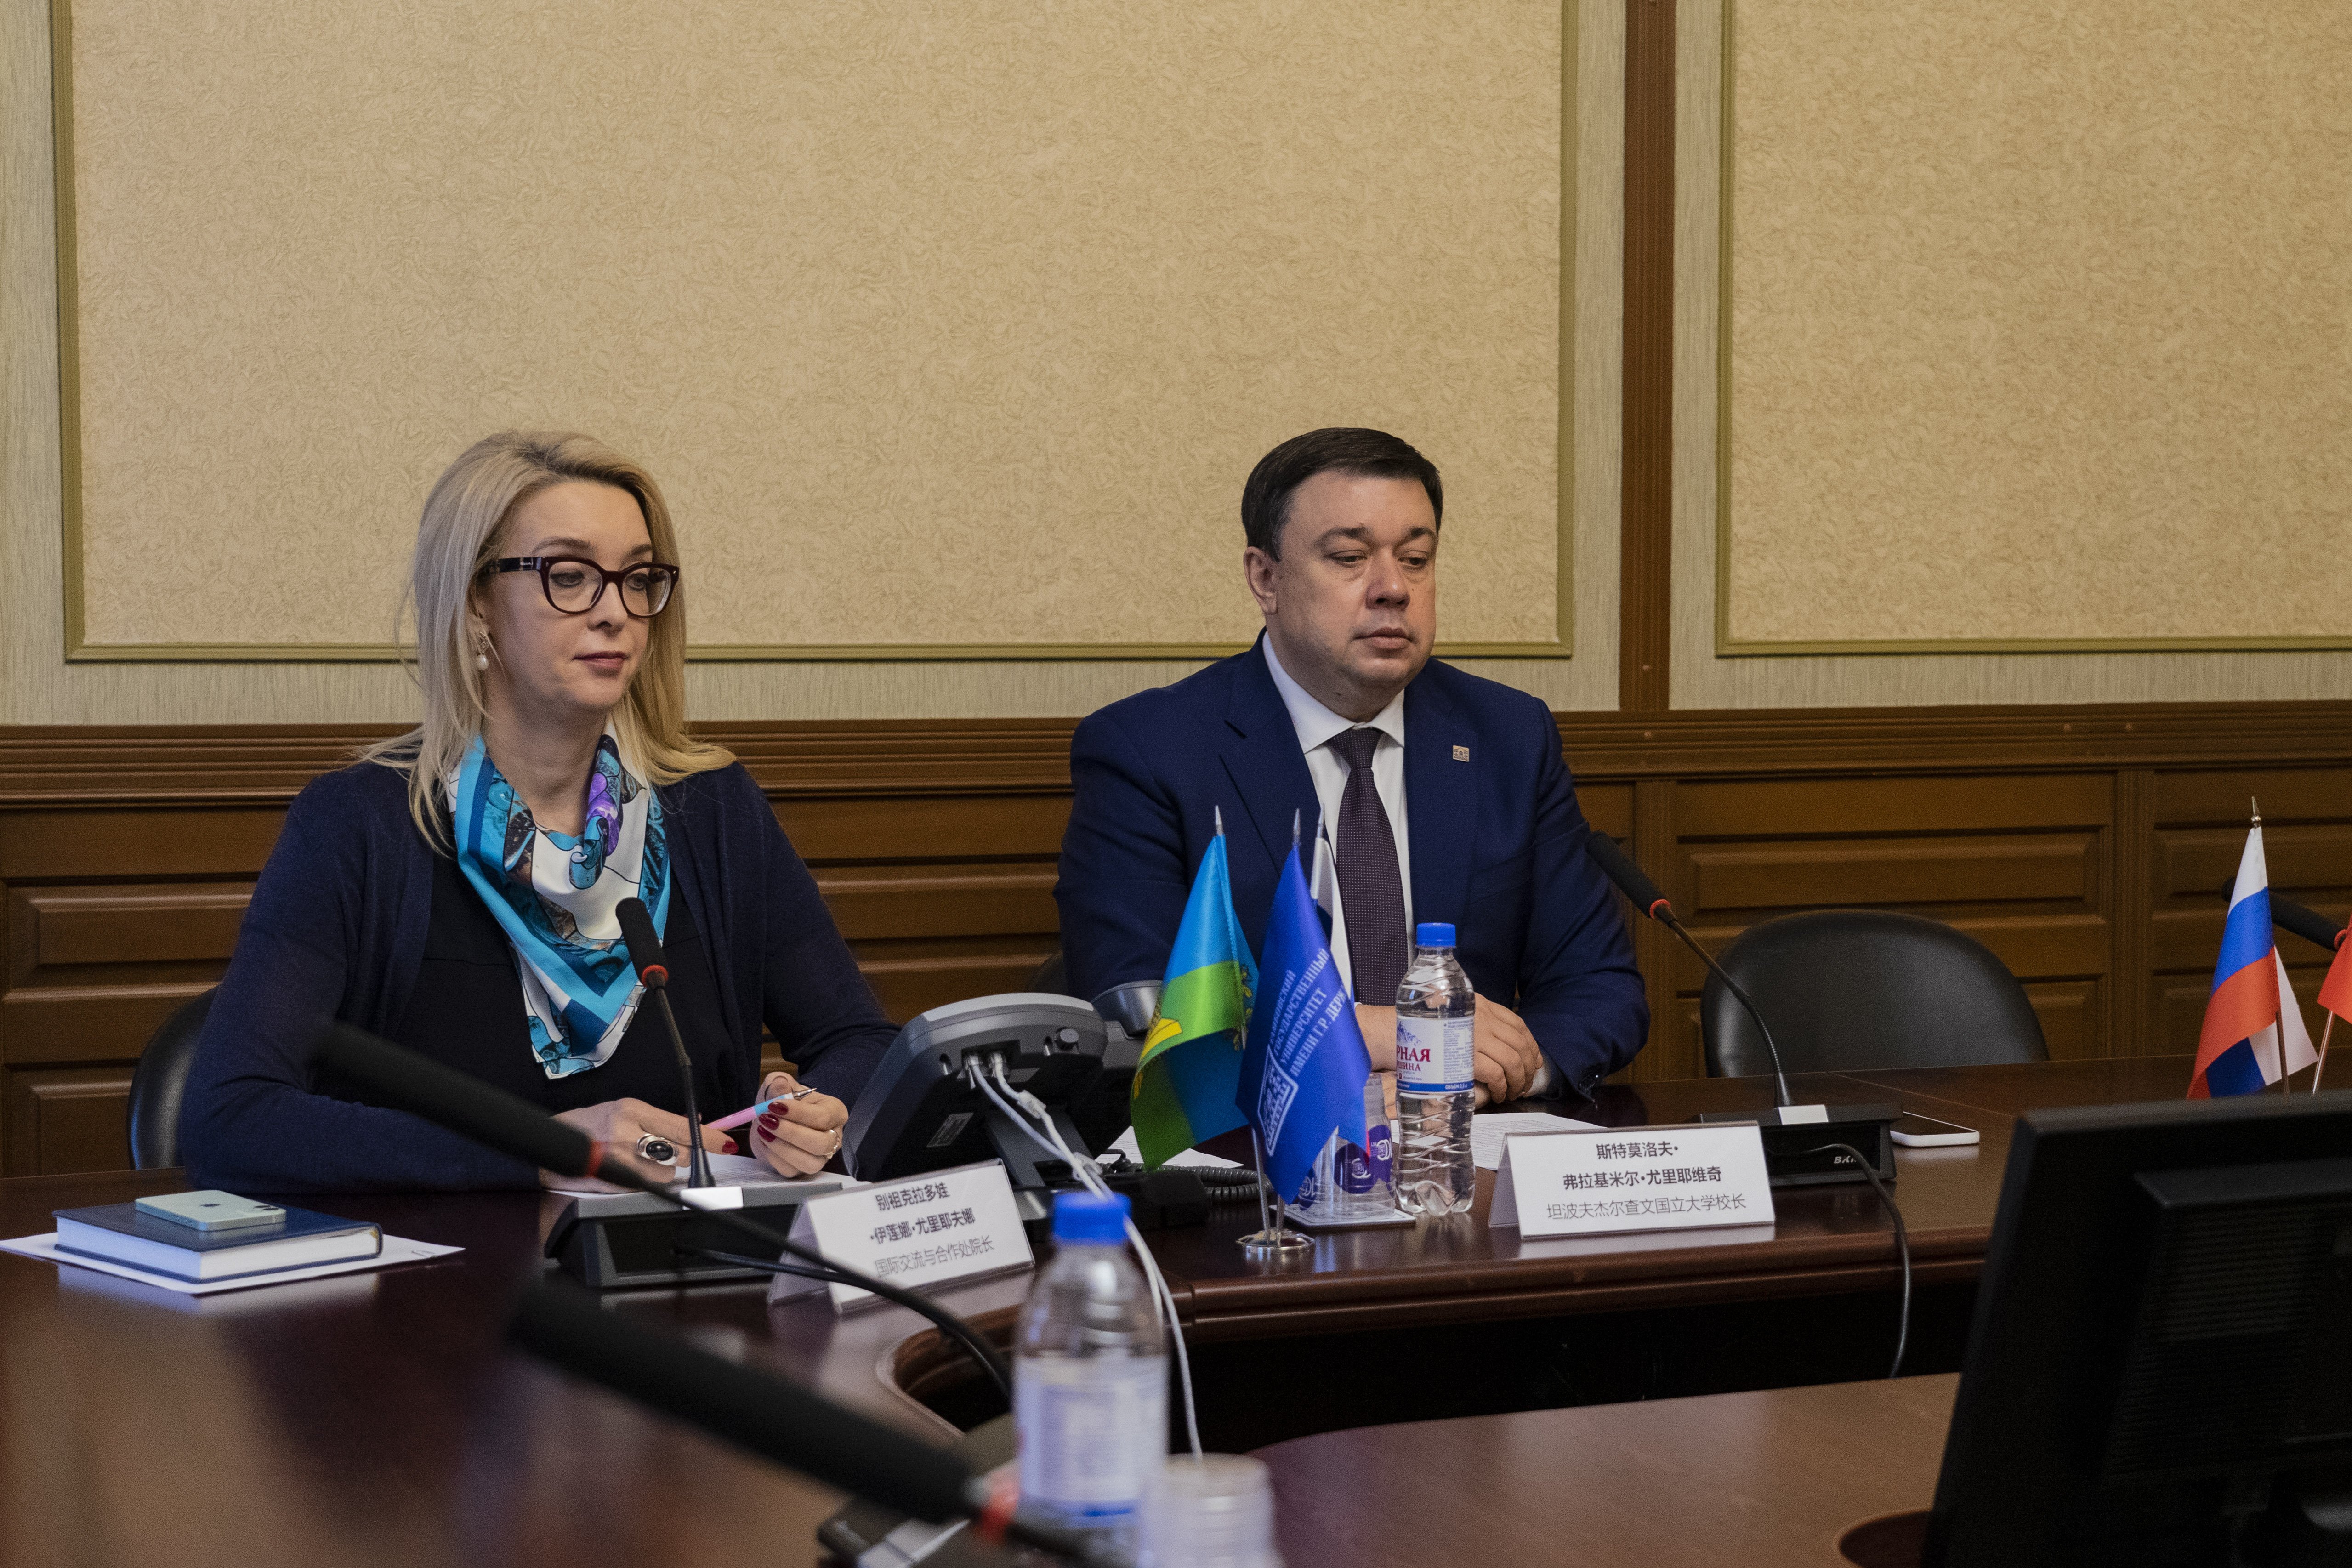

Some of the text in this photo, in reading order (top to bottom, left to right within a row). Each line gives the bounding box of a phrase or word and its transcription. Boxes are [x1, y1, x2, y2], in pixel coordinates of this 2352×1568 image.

[1280, 987, 1327, 1065] УНИВЕРСИТЕТ
[1290, 1034, 1319, 1077] ИМЕНИ
[1563, 1165, 1721, 1190] 弗拉基米尔·尤里耶维奇
[875, 1181, 950, 1211] 别祖克拉多娃
[1547, 1193, 1746, 1220] 坦波夫杰尔查文国立大学校长
[875, 1235, 995, 1278] 国际交流与合作处院长
